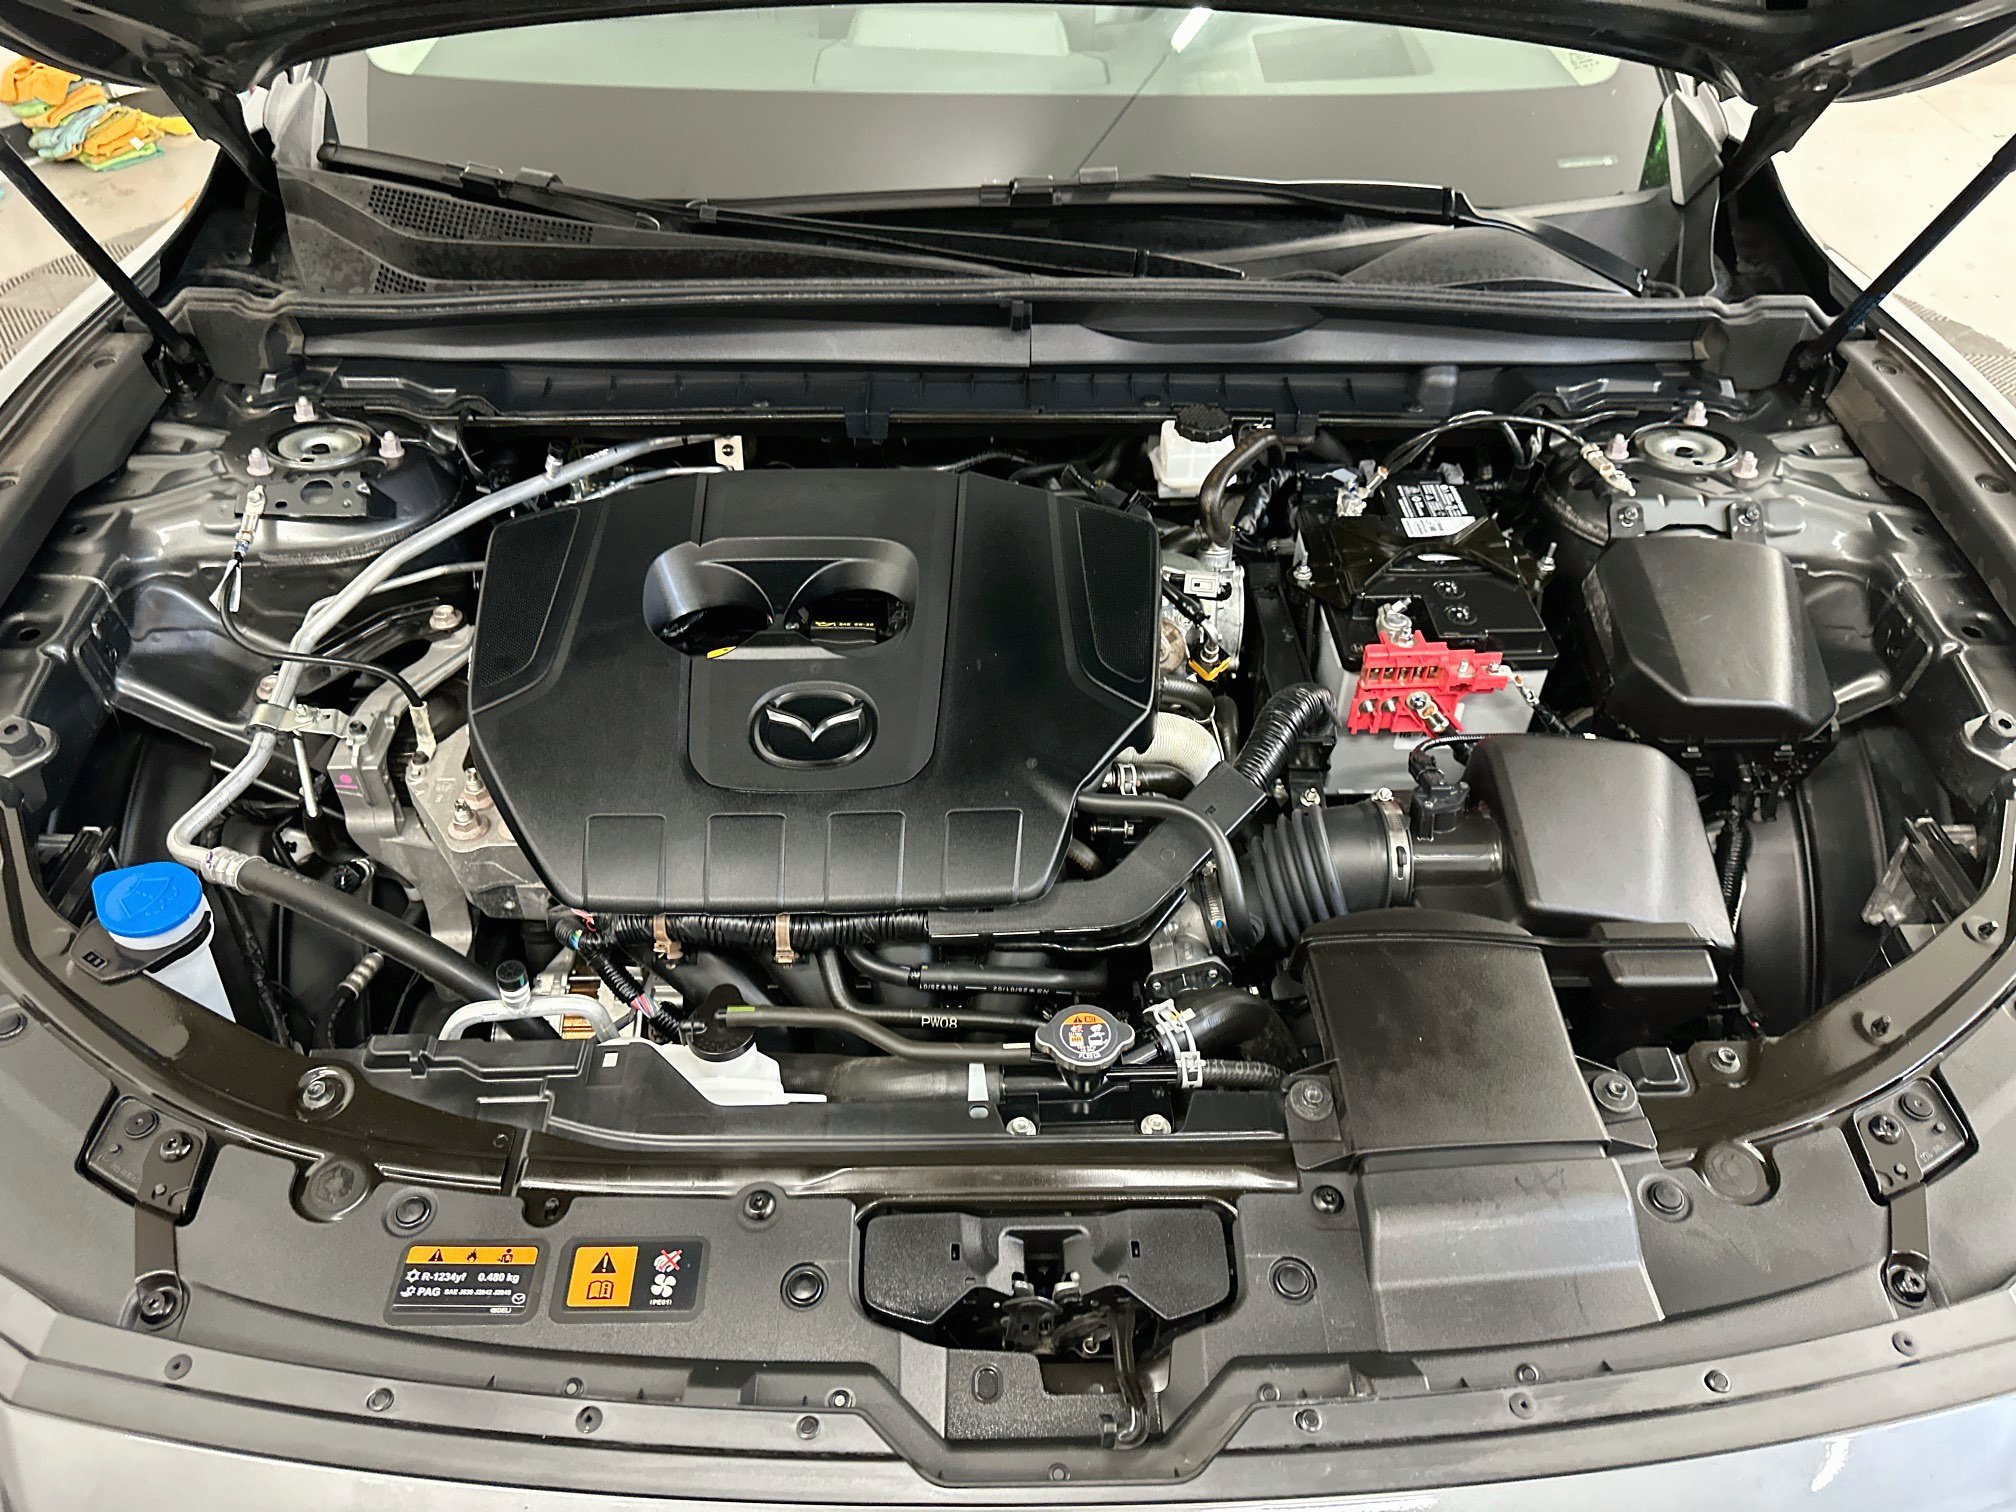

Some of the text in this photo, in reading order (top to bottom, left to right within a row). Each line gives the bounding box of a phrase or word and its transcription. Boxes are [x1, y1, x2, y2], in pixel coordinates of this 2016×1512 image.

[921, 1016, 957, 1028] PW08
[421, 1272, 519, 1284] R-1234yf 0.480 kg
[417, 1287, 441, 1296] PAG
